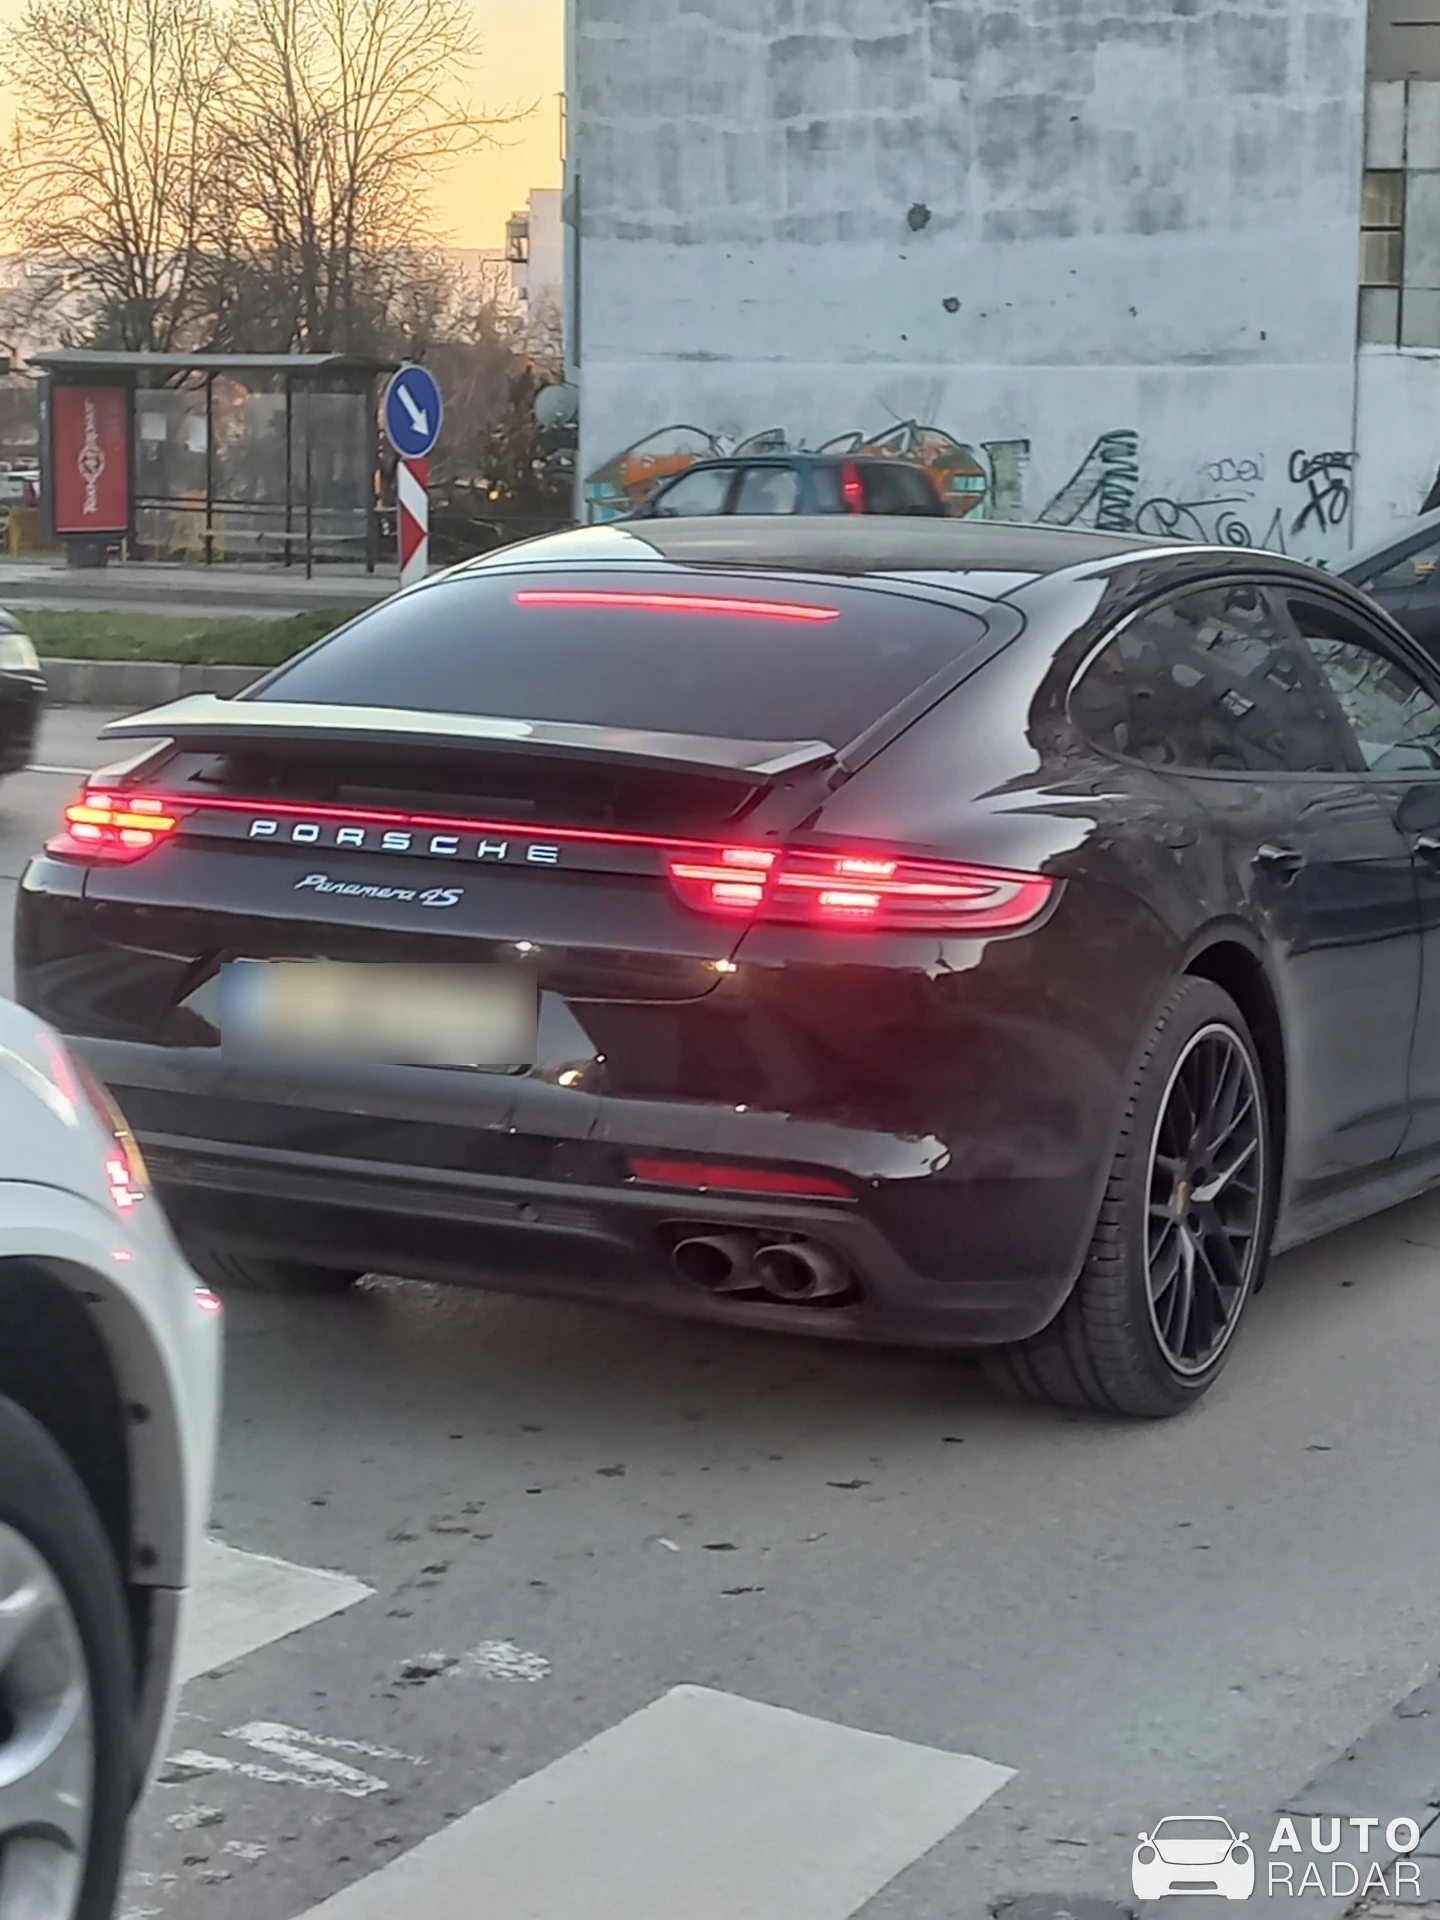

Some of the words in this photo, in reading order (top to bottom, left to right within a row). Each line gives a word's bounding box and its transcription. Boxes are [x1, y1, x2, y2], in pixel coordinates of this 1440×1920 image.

[249, 819, 561, 863] PORSCHE
[294, 873, 417, 901] Panamera
[419, 888, 464, 907] 4S
